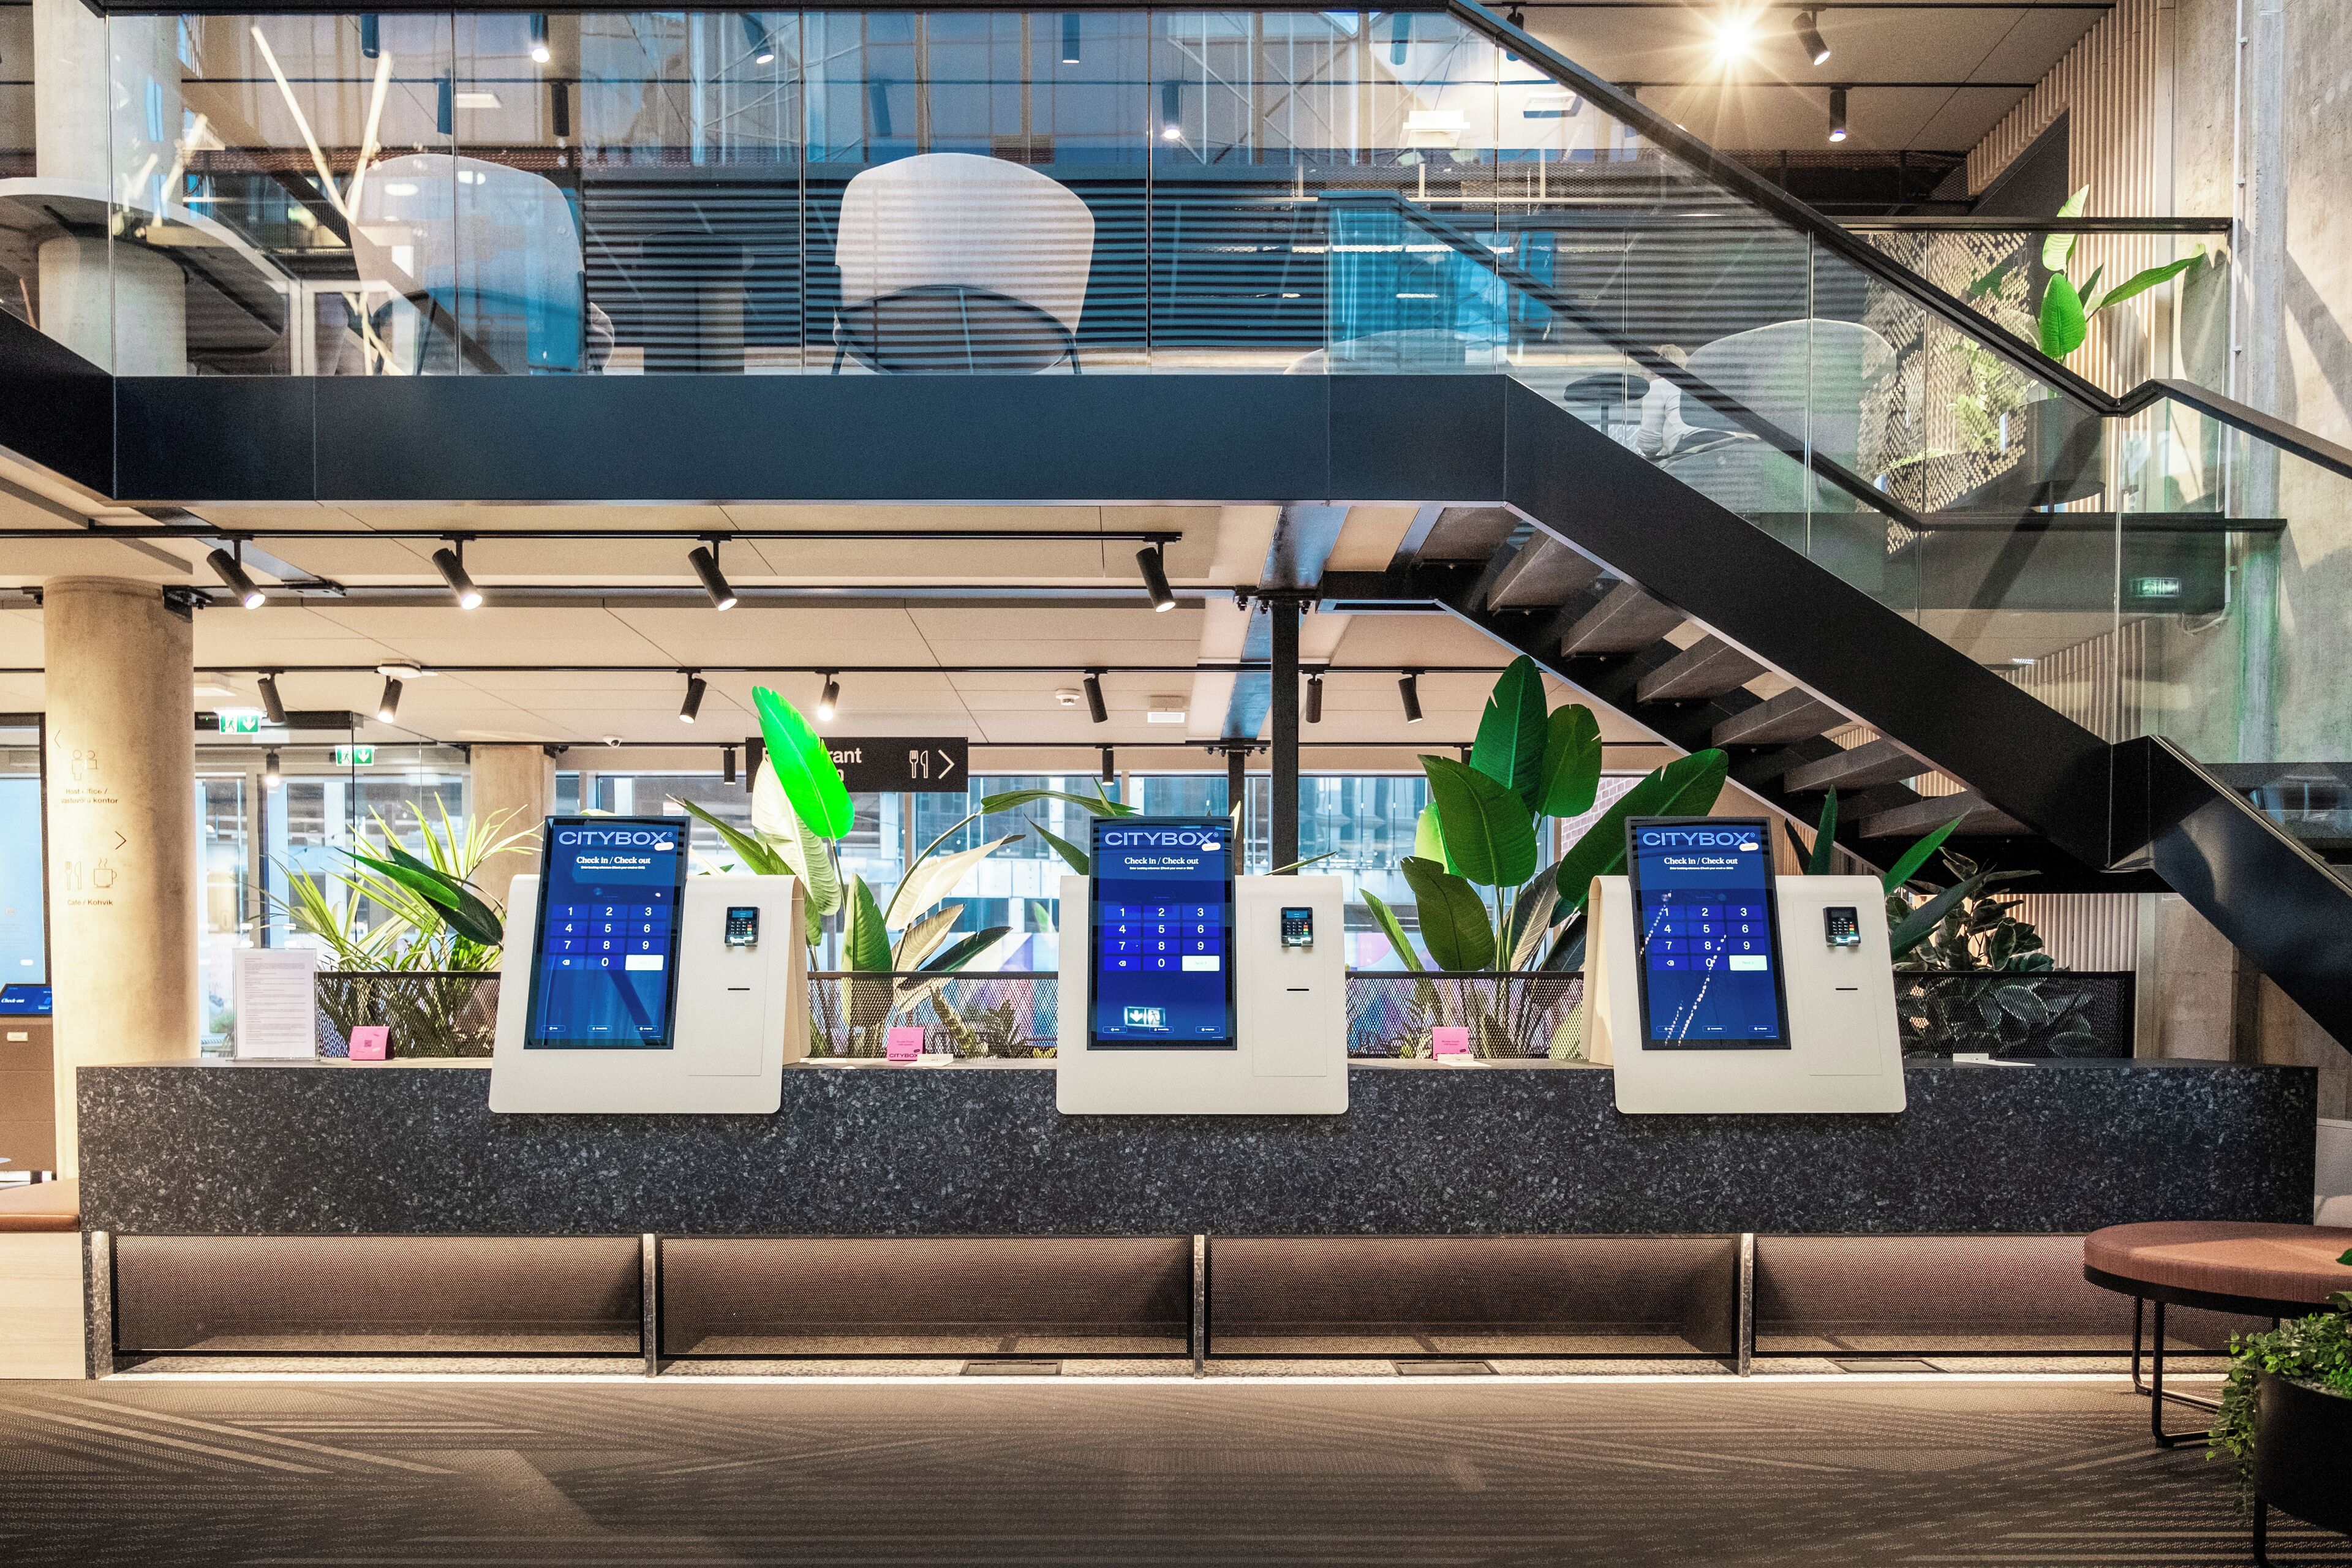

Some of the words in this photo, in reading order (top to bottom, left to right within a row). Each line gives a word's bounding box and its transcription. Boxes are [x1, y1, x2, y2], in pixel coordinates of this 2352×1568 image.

[568, 907, 573, 916] 1
[605, 907, 613, 916] 2
[644, 907, 652, 916] 3
[1120, 908, 1125, 917] 1
[1158, 907, 1165, 917] 2
[1197, 907, 1204, 917] 3
[1664, 908, 1668, 916] 1
[1702, 907, 1709, 916] 2
[1740, 907, 1747, 916] 3
[565, 923, 573, 933] 4
[604, 924, 612, 933] 5
[643, 924, 650, 933] 6
[1118, 924, 1126, 934] 4
[1158, 924, 1165, 933] 5
[1197, 924, 1204, 933] 6
[1664, 924, 1672, 933] 4
[1703, 924, 1710, 933] 5
[1741, 924, 1749, 933] 6
[564, 940, 571, 949] 7
[603, 940, 610, 950] 8
[642, 940, 649, 950] 9
[1118, 941, 1126, 951] 7
[1158, 941, 1165, 951] 8
[1197, 941, 1204, 951] 9
[1665, 941, 1672, 950] 7
[1704, 941, 1711, 950] 8
[1743, 941, 1751, 950] 9
[601, 957, 609, 967] 0
[1158, 958, 1165, 968] 0
[1705, 958, 1713, 967] 0
